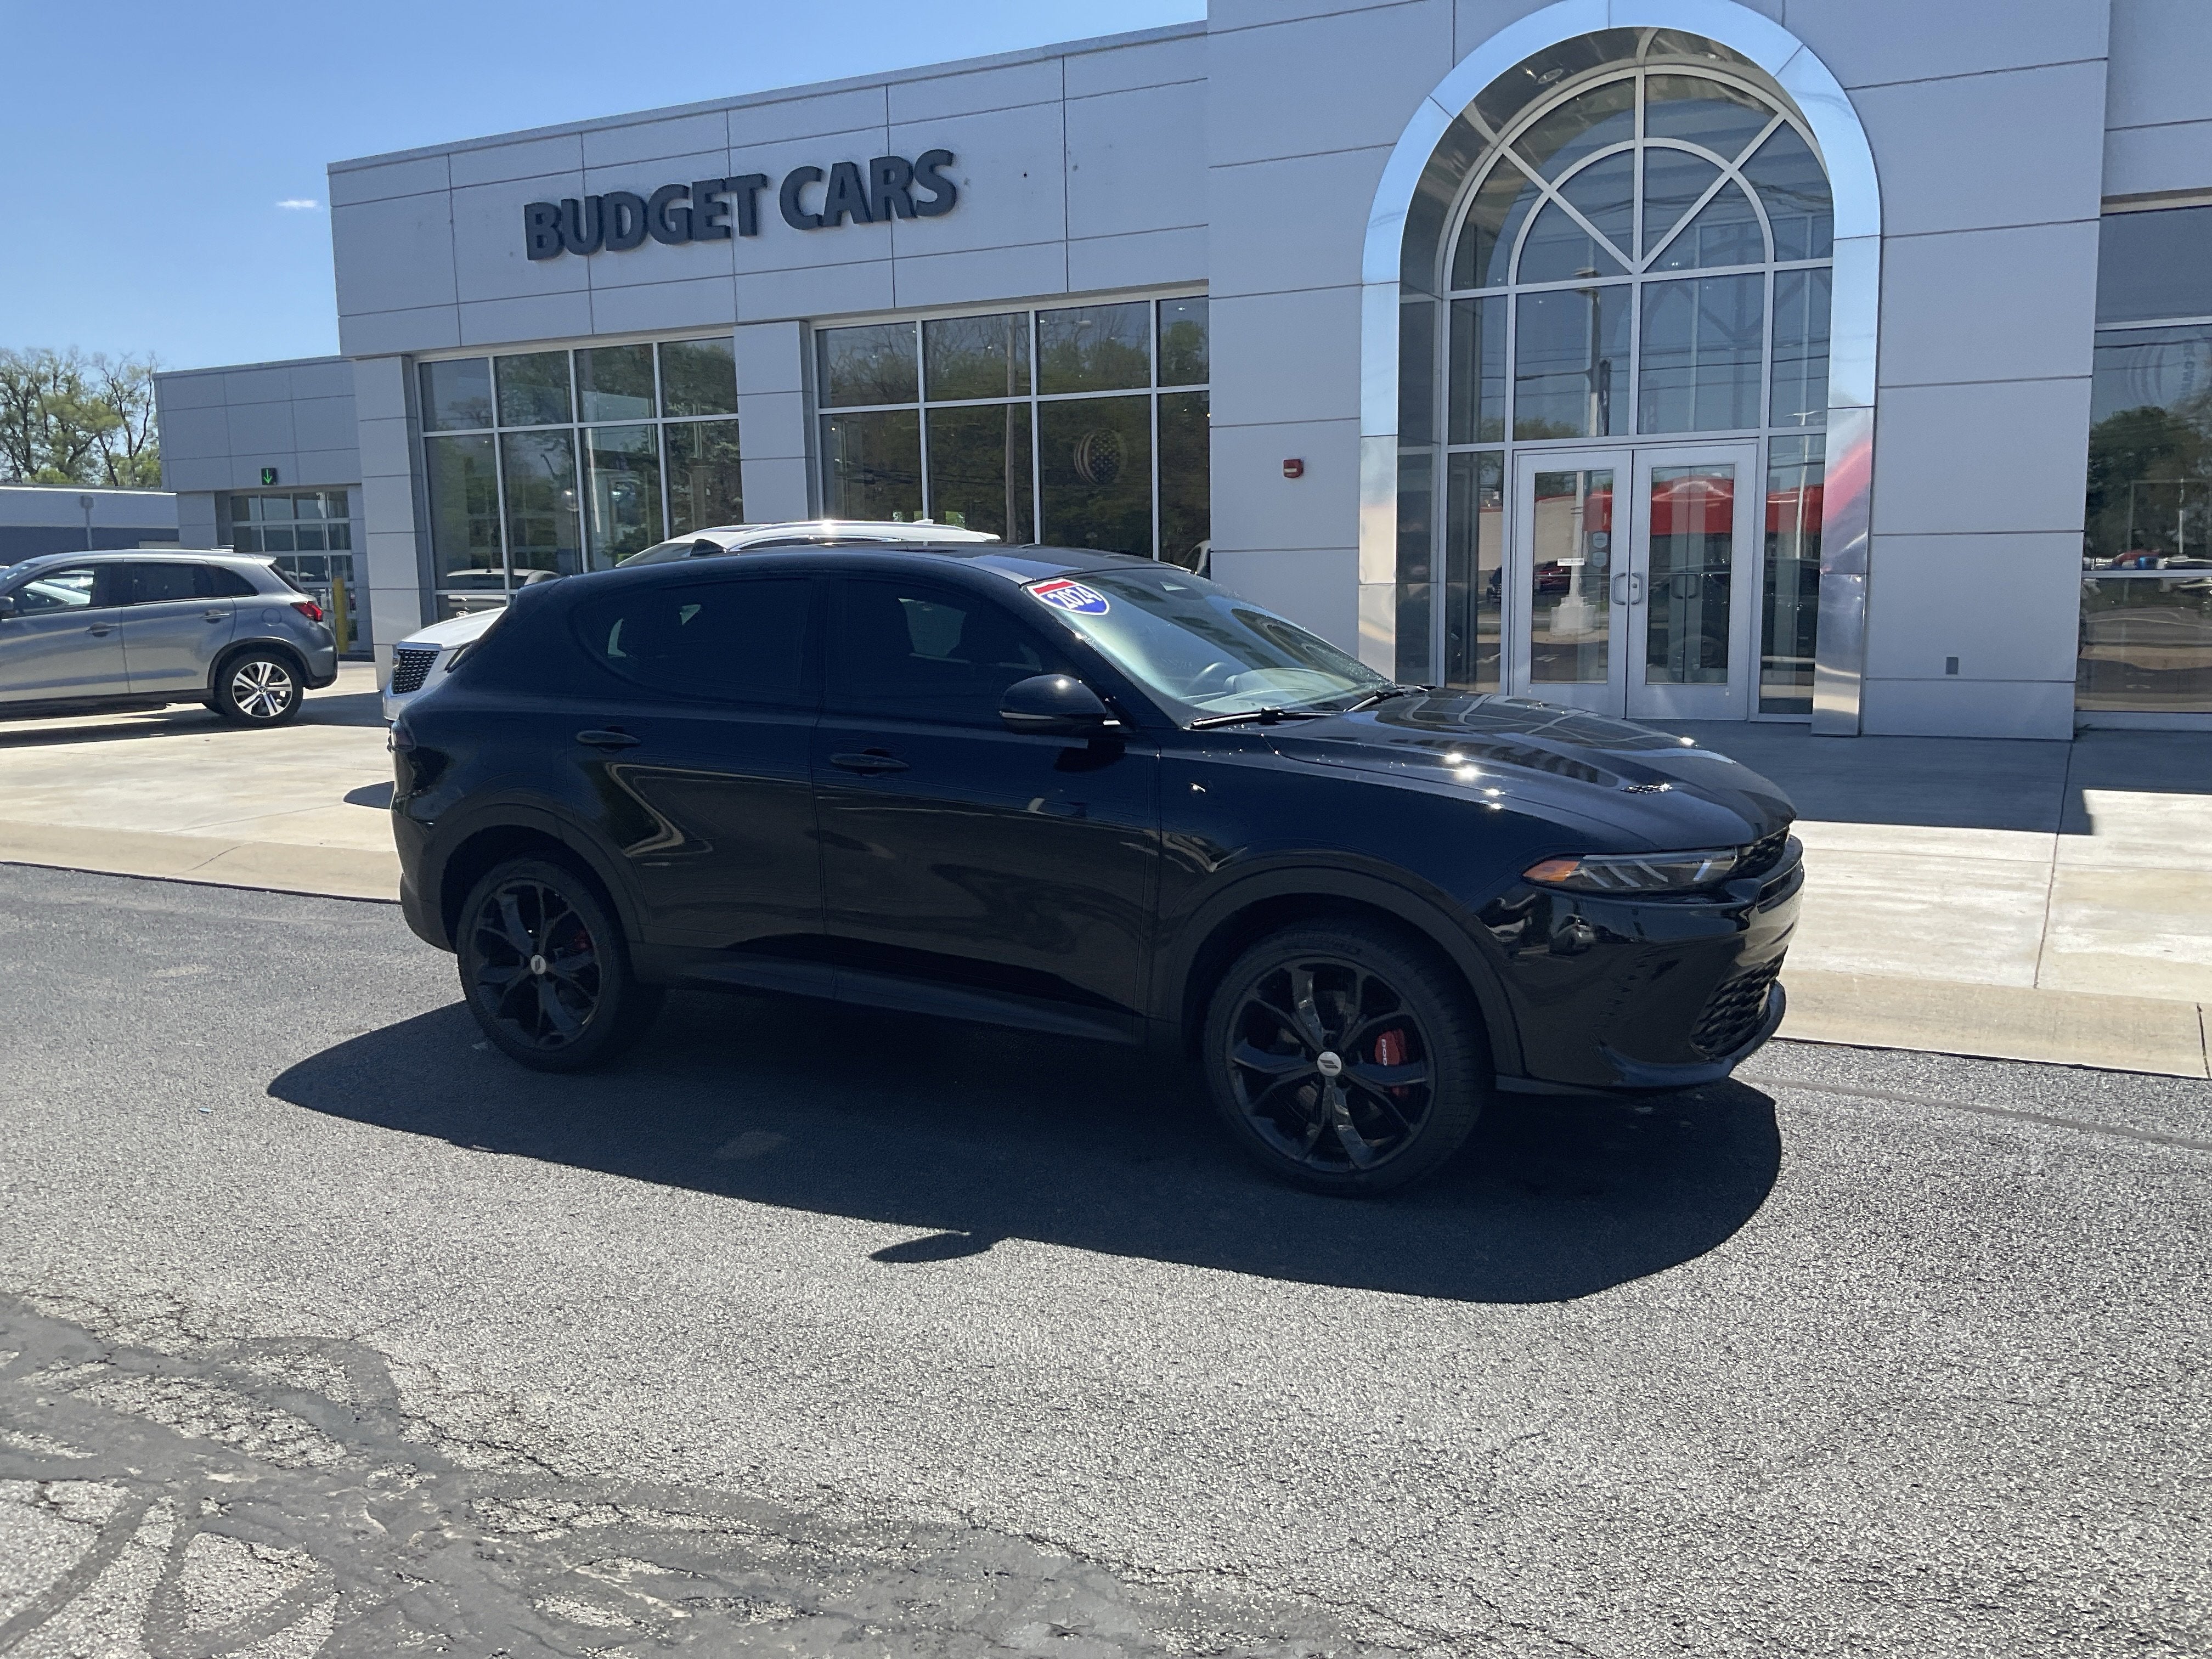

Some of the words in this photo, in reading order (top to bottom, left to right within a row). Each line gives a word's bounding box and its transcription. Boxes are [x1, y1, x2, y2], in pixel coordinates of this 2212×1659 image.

[523, 173, 769, 261] BUDGET
[779, 149, 957, 230] CARS
[1047, 585, 1102, 609] 2024
